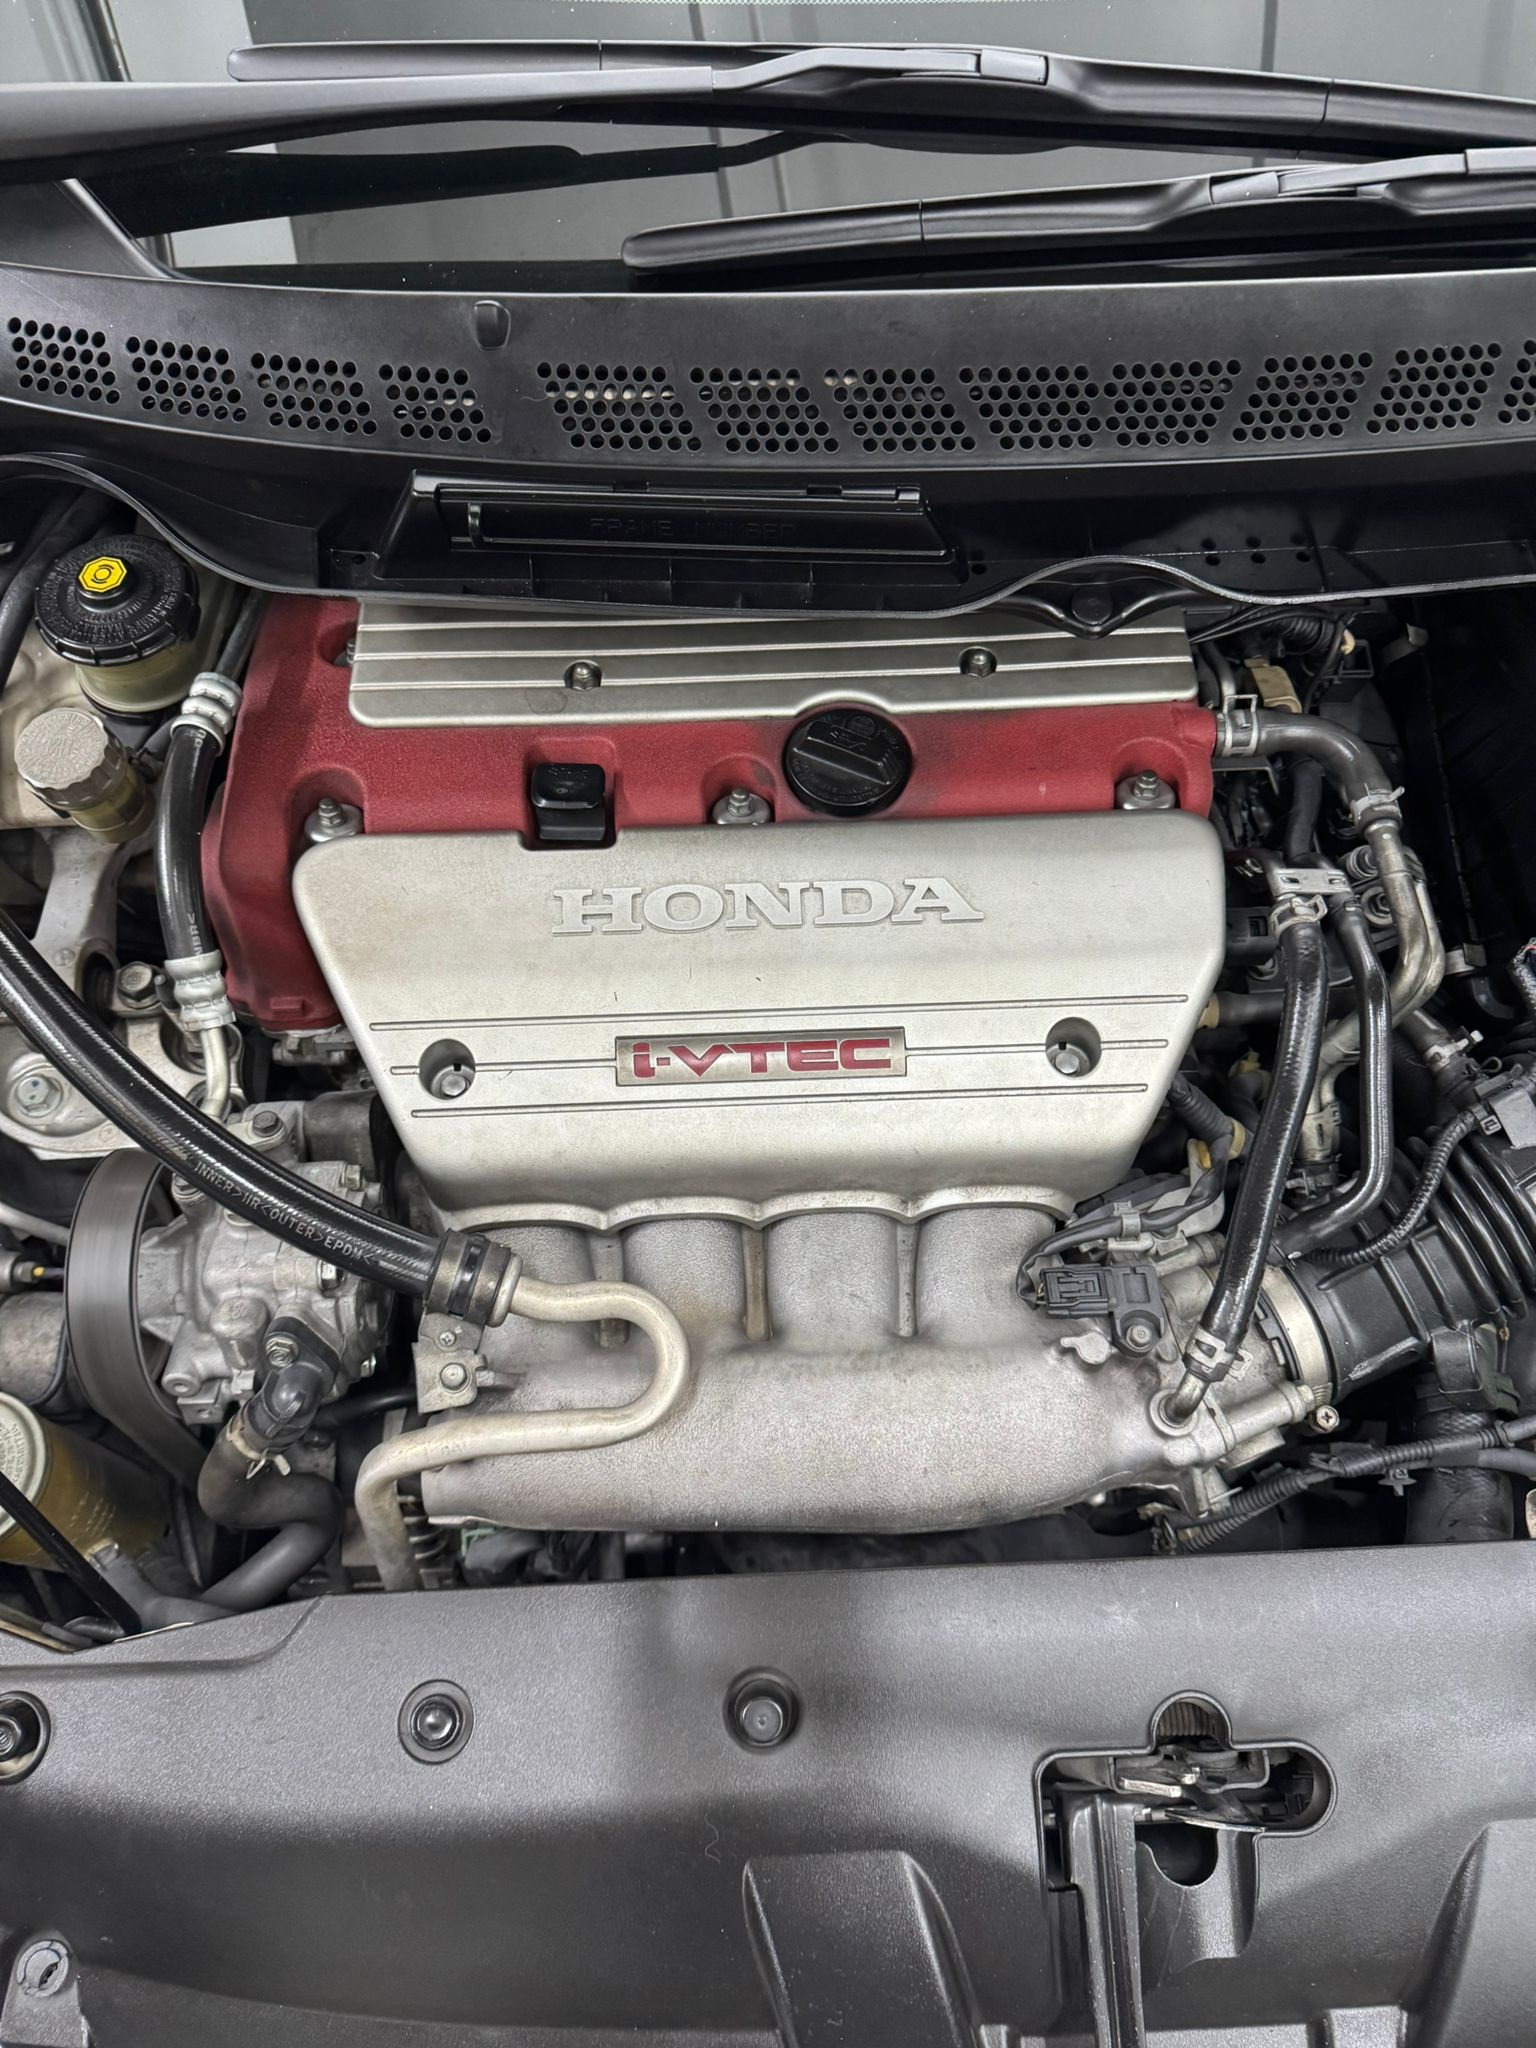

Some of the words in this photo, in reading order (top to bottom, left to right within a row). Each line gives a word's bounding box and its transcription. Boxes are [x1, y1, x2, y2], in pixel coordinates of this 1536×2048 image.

[589, 517, 674, 538] FRAME
[552, 877, 985, 934] HONDA
[632, 1037, 892, 1078] i-VTEC
